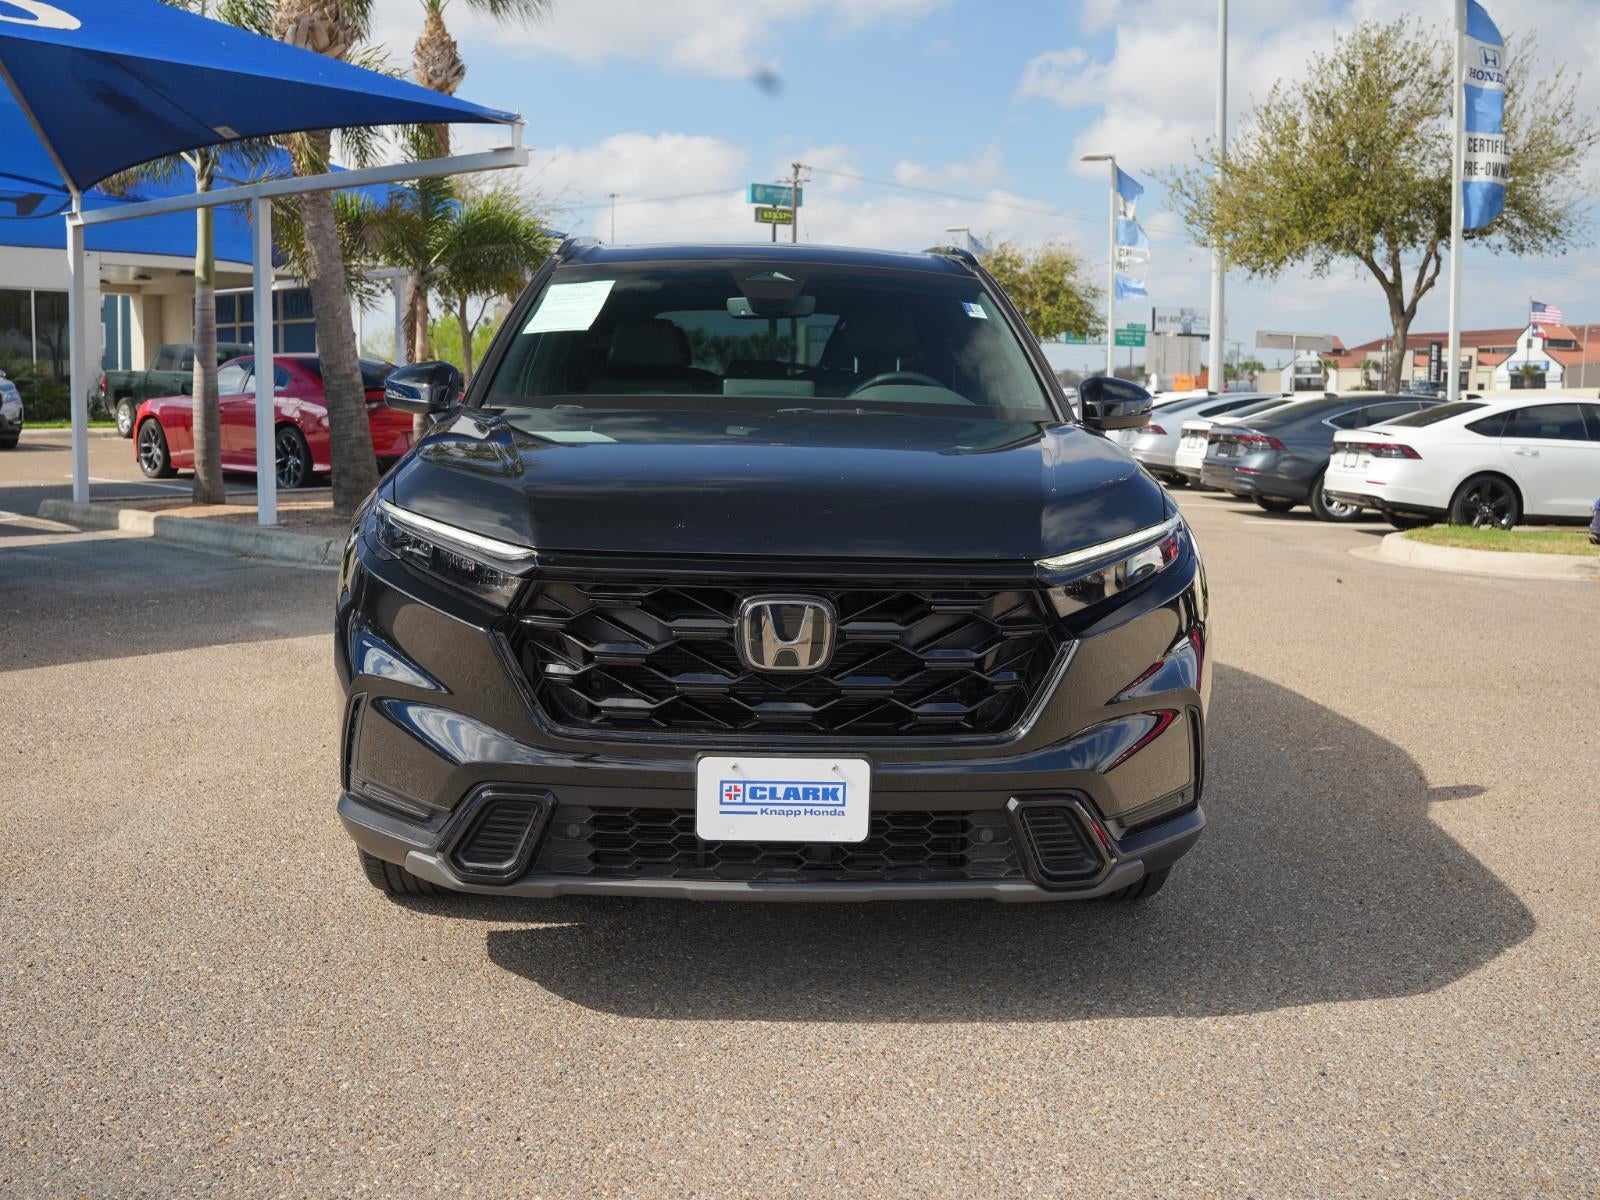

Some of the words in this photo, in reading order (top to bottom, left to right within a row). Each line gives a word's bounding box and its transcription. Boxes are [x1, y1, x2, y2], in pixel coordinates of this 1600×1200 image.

[1468, 67, 1505, 85] HOND
[1467, 137, 1510, 155] CERTIFIE
[748, 786, 840, 802] CLARK
[760, 807, 802, 818] Knapp
[804, 807, 846, 817] Honda
